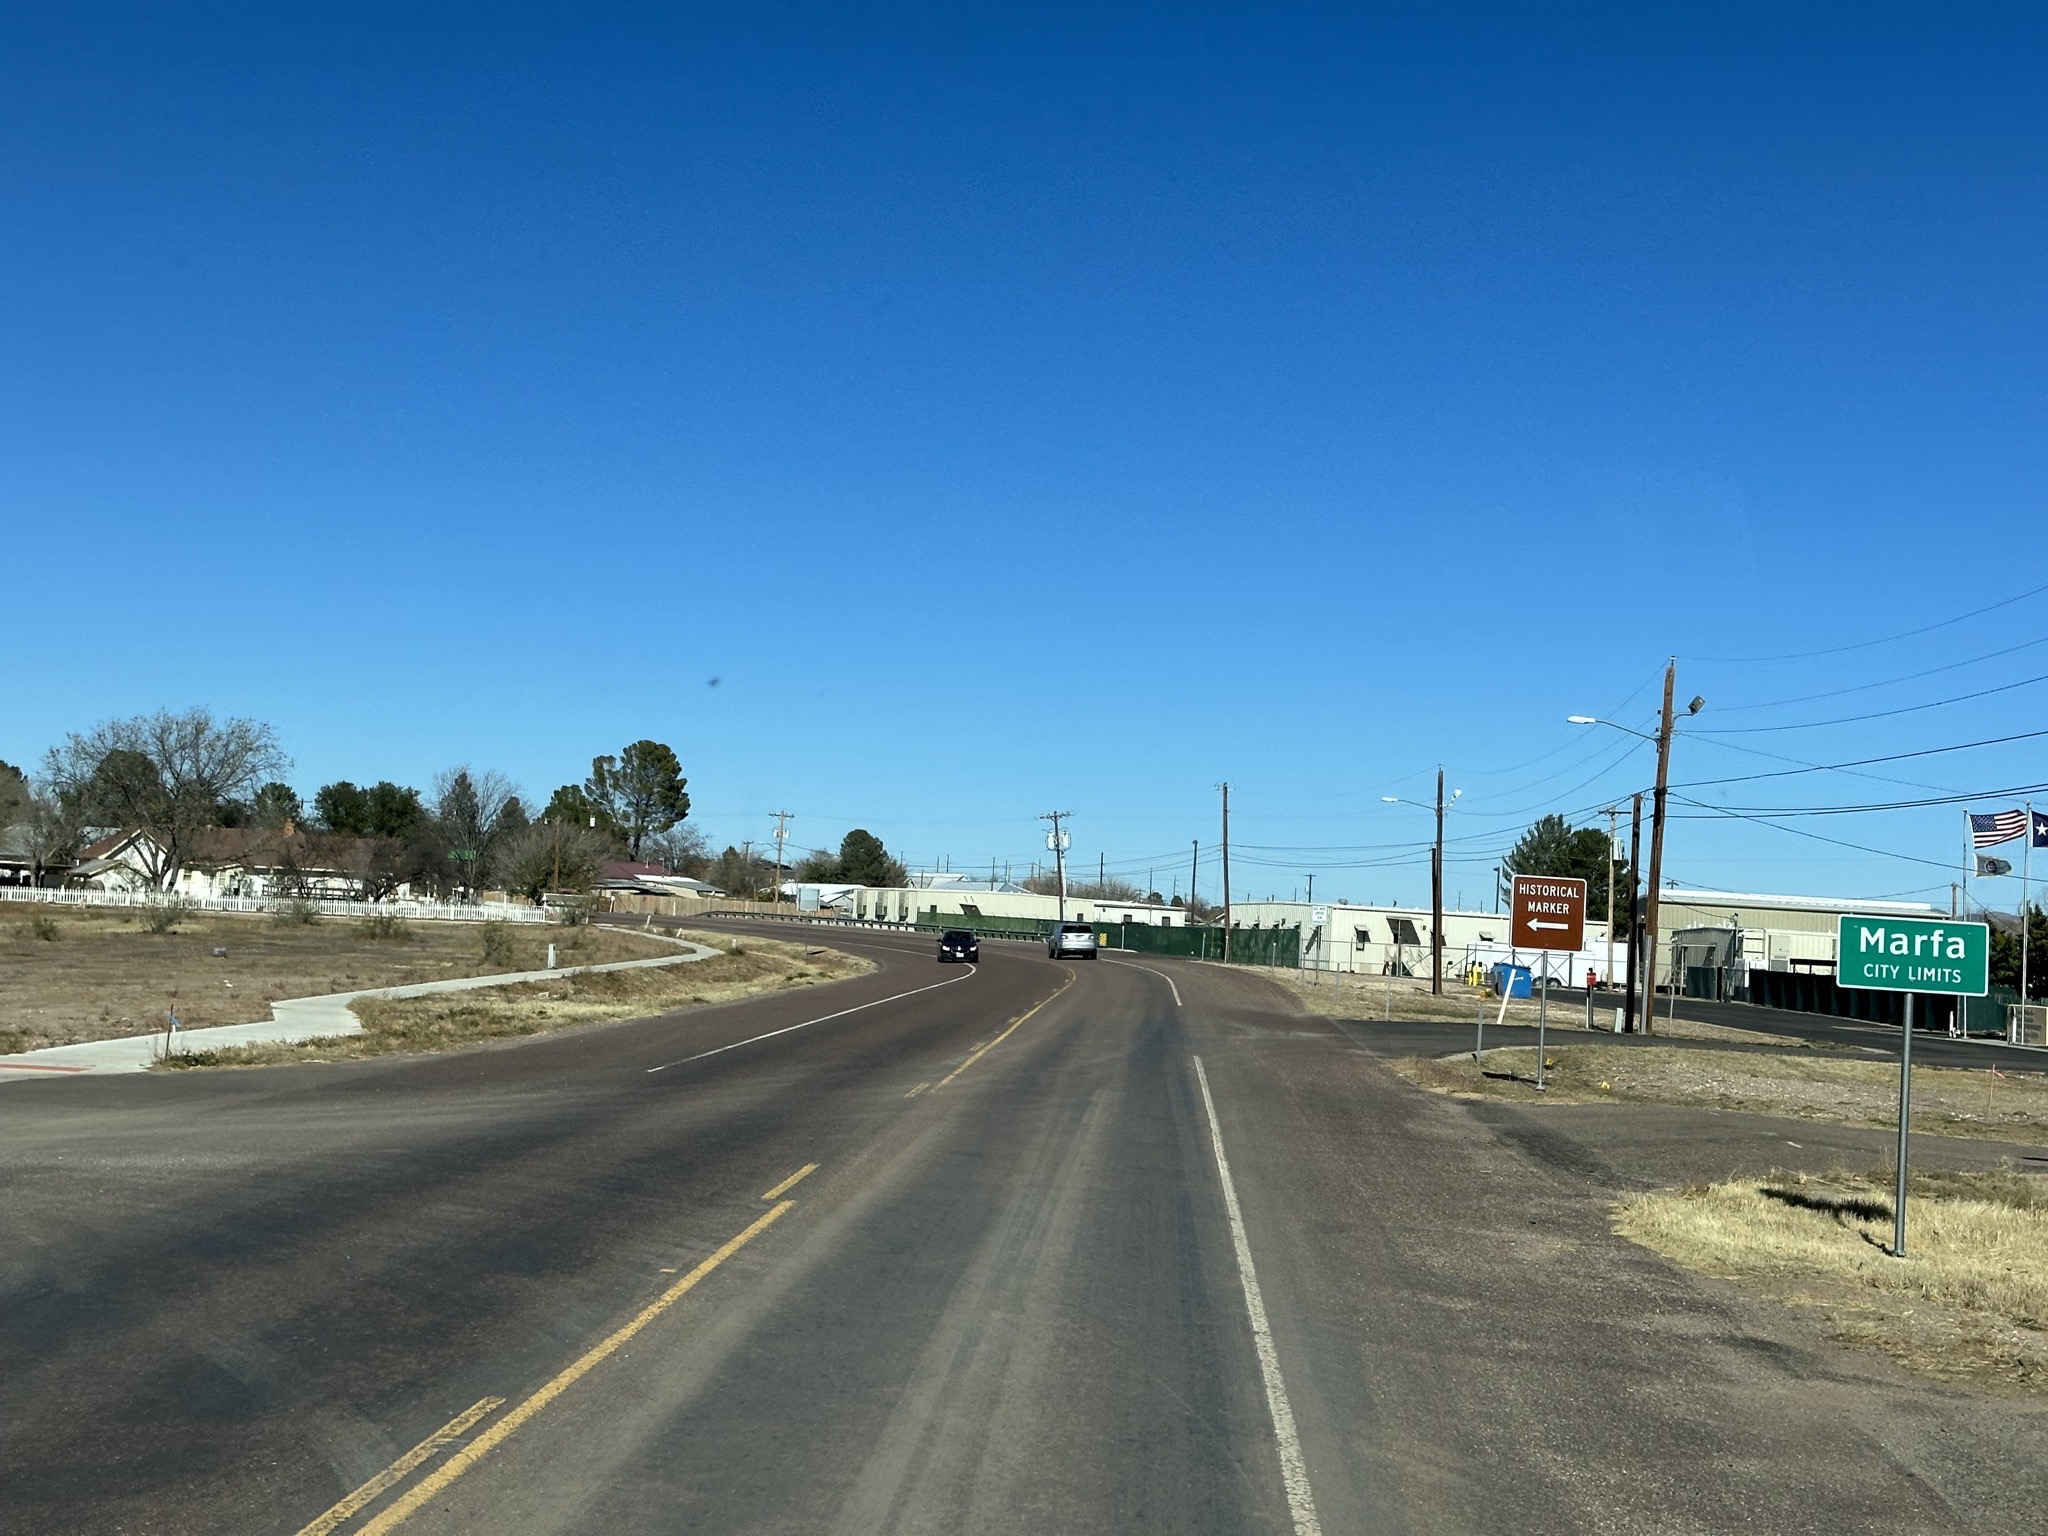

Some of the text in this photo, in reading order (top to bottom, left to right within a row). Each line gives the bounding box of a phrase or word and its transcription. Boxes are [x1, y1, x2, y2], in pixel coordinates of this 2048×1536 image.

[1519, 883, 1580, 898] HISTORICAL
[1527, 901, 1570, 915] MARKER
[1859, 926, 1966, 959] Marfa
[1863, 963, 1962, 984] CITY LIMITS
